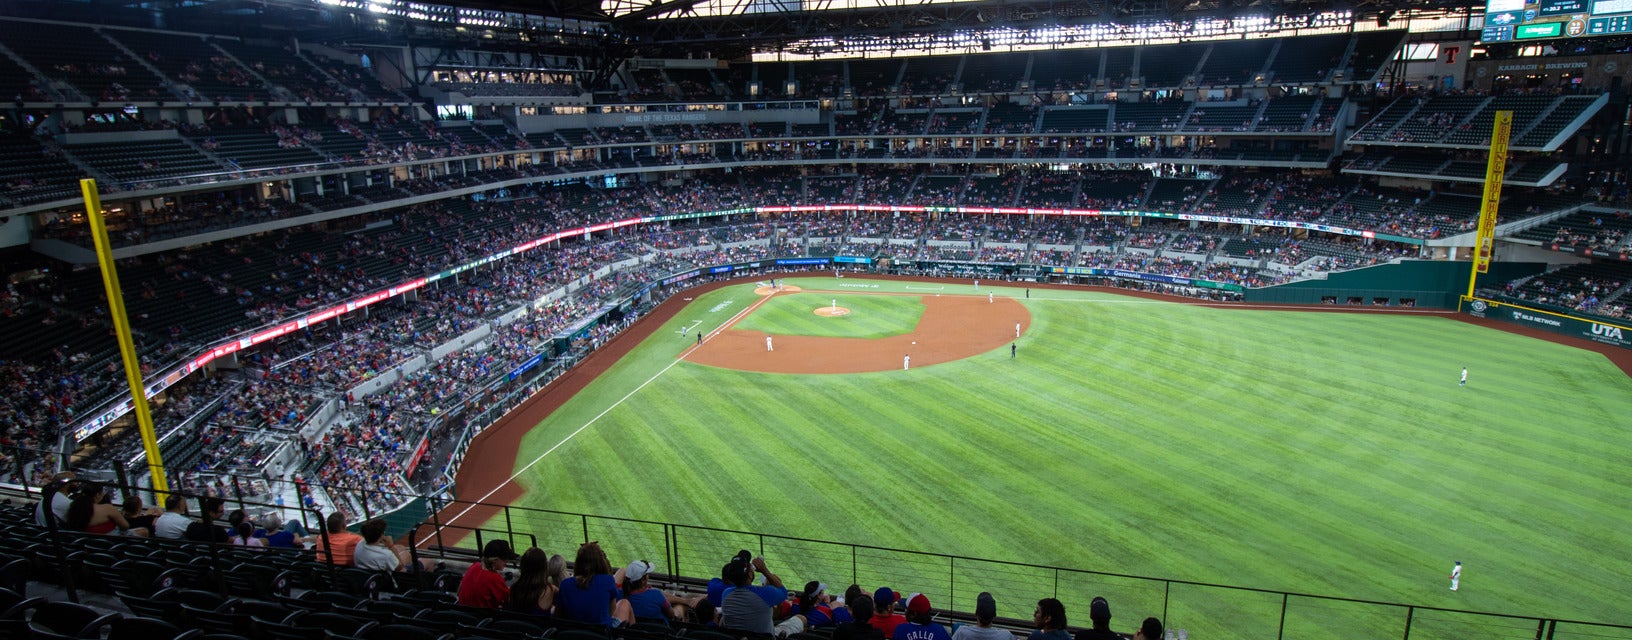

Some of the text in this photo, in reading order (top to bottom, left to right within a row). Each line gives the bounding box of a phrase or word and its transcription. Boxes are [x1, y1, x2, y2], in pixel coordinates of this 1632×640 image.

[1444, 46, 1460, 64] T
[682, 113, 706, 121] RANGERS
[1114, 270, 1141, 279] Germania
[1534, 316, 1561, 327] NETWORK
[1591, 323, 1623, 340] UTA
[906, 630, 934, 640] GALLO
